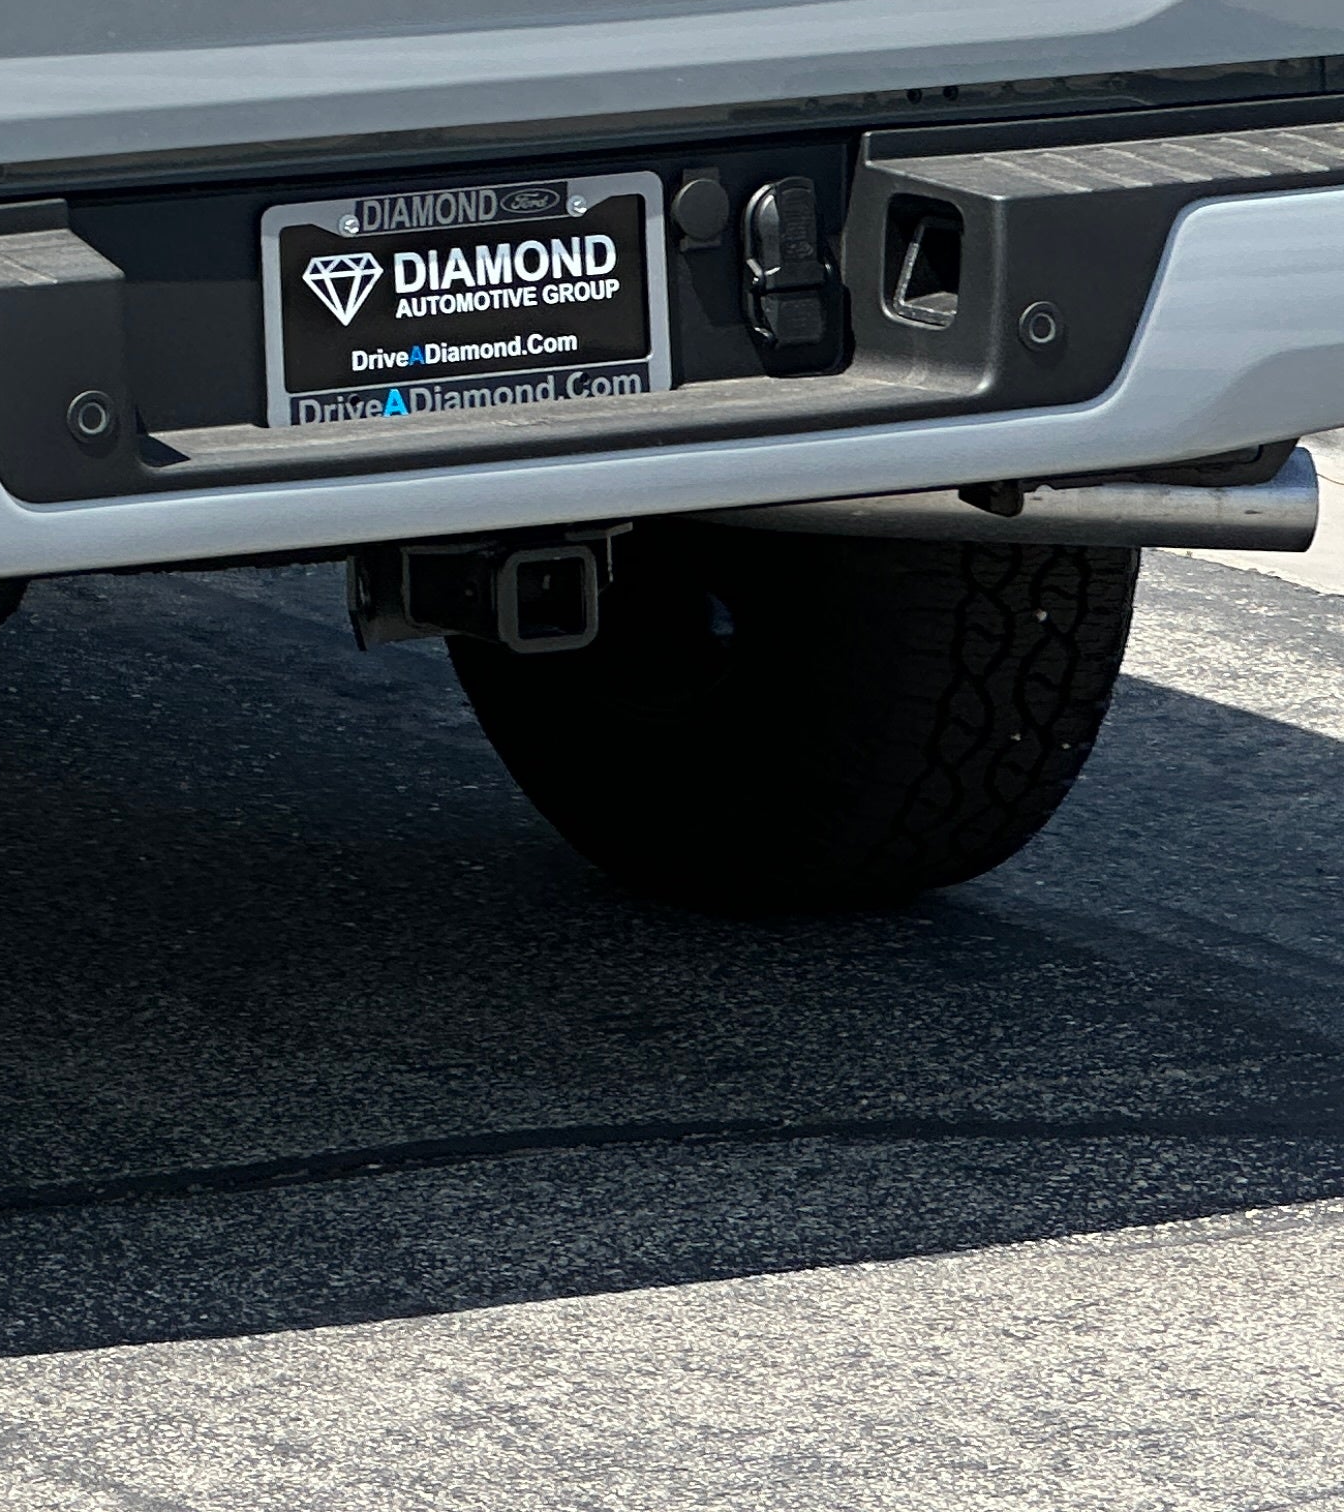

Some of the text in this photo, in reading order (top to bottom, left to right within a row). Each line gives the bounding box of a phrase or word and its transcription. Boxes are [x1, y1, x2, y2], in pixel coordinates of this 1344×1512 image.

[361, 189, 498, 232] DIAMOND
[393, 234, 617, 294] DIAMOND
[394, 278, 620, 320] AUTOMOTIVE GROUP
[351, 333, 578, 373] DriveADiamond.Com
[298, 370, 643, 427] DriveADiamond.Com
